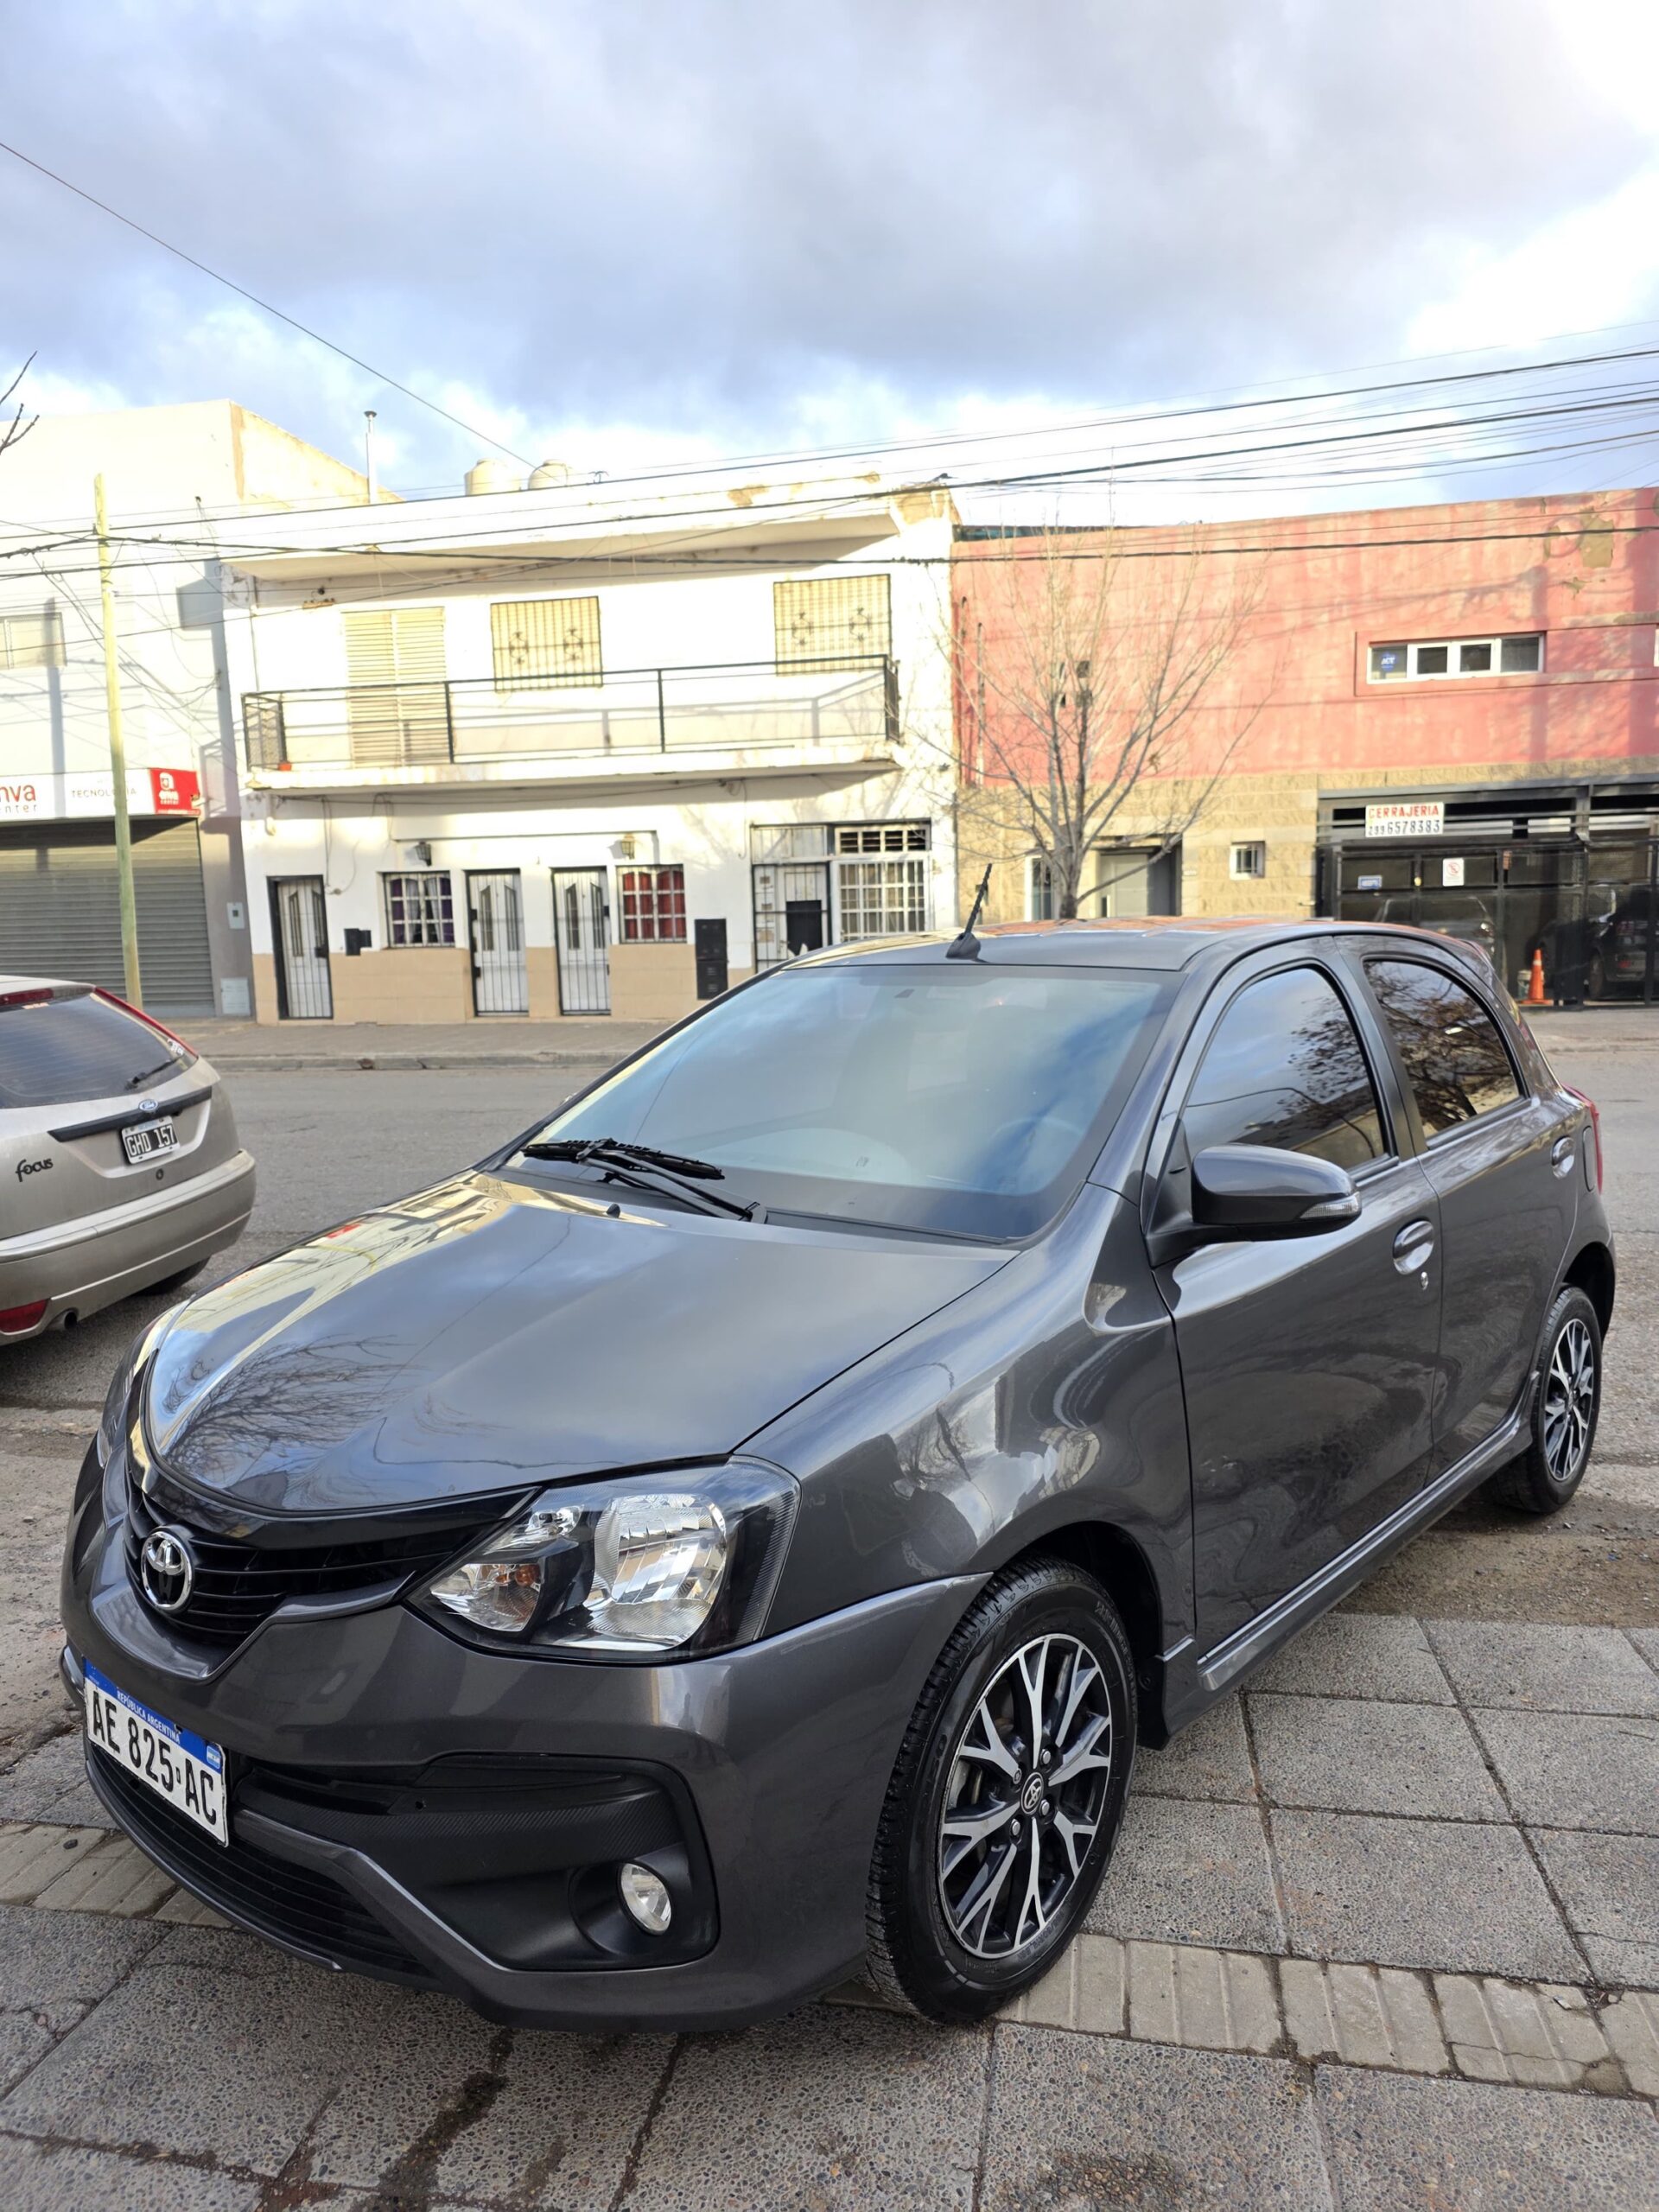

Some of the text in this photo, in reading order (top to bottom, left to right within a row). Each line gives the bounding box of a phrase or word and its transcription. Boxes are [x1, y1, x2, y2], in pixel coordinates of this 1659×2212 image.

[72, 788, 137, 798] TECNOLIA
[0, 804, 37, 813] nter
[1369, 805, 1439, 819] CERRAJERIA
[126, 1125, 175, 1155] GHD 157
[147, 1713, 180, 1745] ARGENTINA
[92, 1691, 120, 1753] AE
[128, 1717, 174, 1792] 825
[185, 1758, 217, 1825] AC
